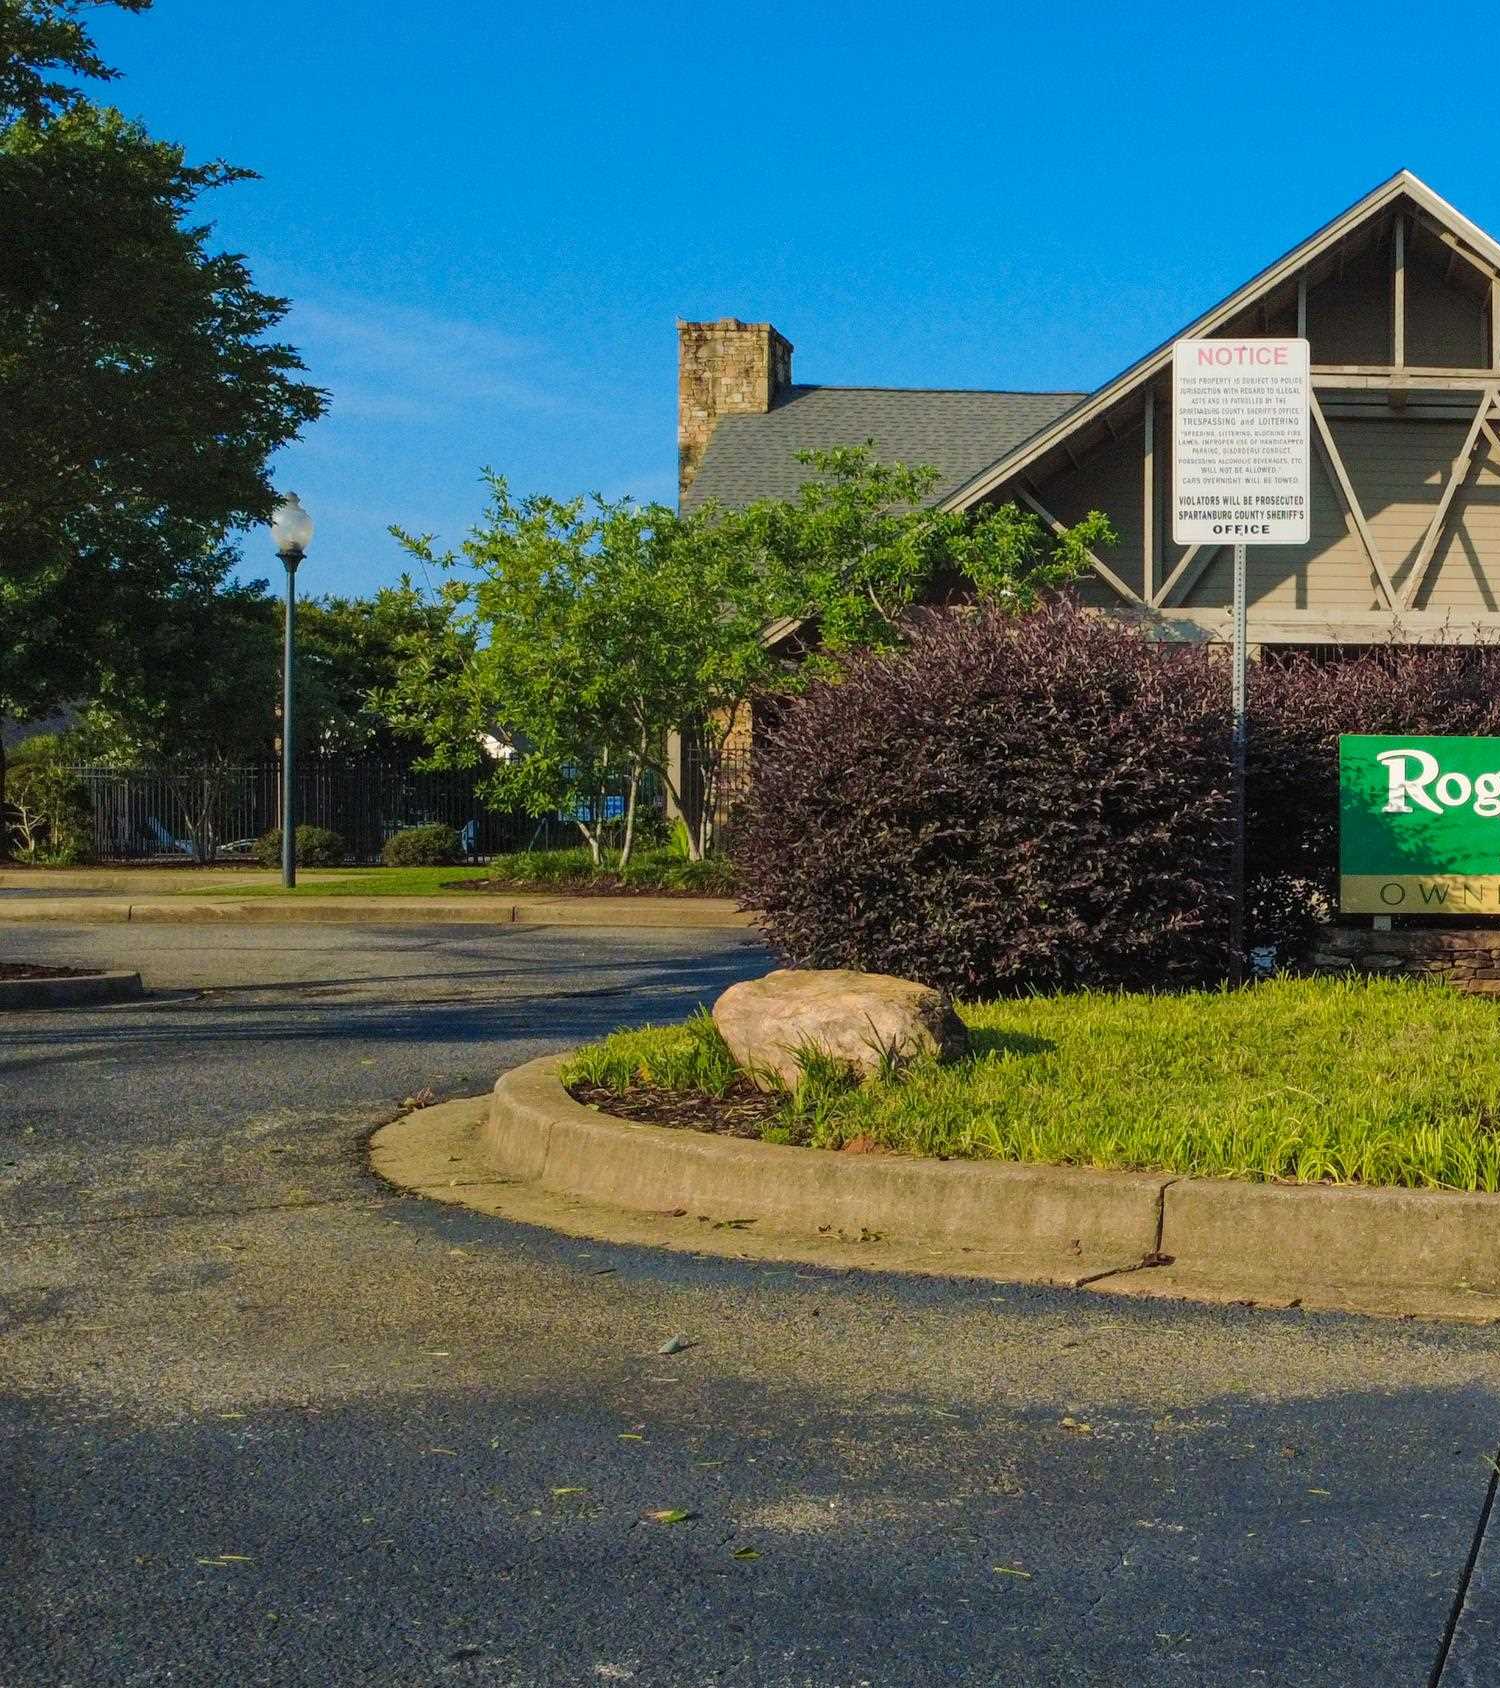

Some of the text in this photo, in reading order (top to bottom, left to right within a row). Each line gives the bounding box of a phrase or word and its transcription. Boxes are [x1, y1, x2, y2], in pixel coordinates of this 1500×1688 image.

[1198, 346, 1288, 365] NOTICE
[1179, 496, 1303, 505] VIOLATORS WILL BE PROSECUTED
[1179, 511, 1304, 520] SPARTANBURG COUNTY SHERIFF'S
[1213, 524, 1270, 534] OFFICE
